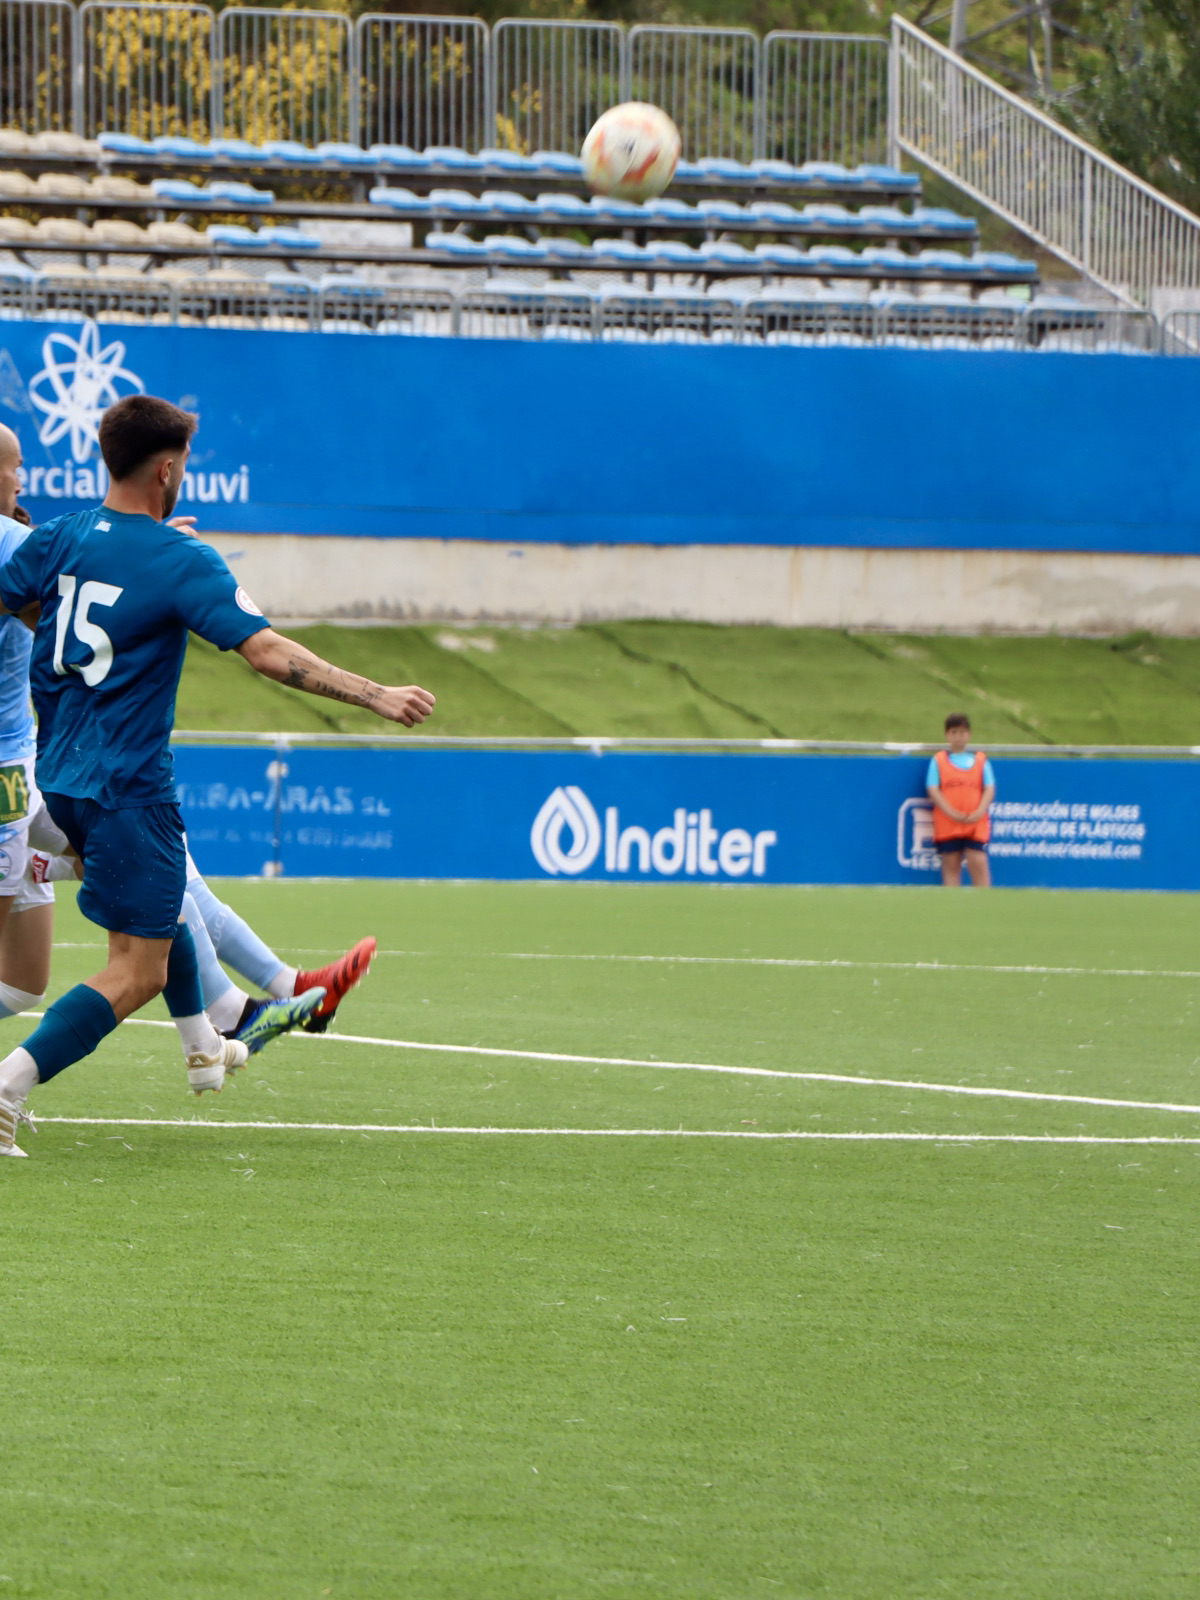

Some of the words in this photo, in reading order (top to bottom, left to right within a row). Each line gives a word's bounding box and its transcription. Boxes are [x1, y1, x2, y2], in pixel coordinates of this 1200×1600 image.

[53, 573, 124, 687] 15
[1060, 821, 1078, 838] DE
[1071, 803, 1089, 820] DE
[605, 806, 777, 877] Inditer
